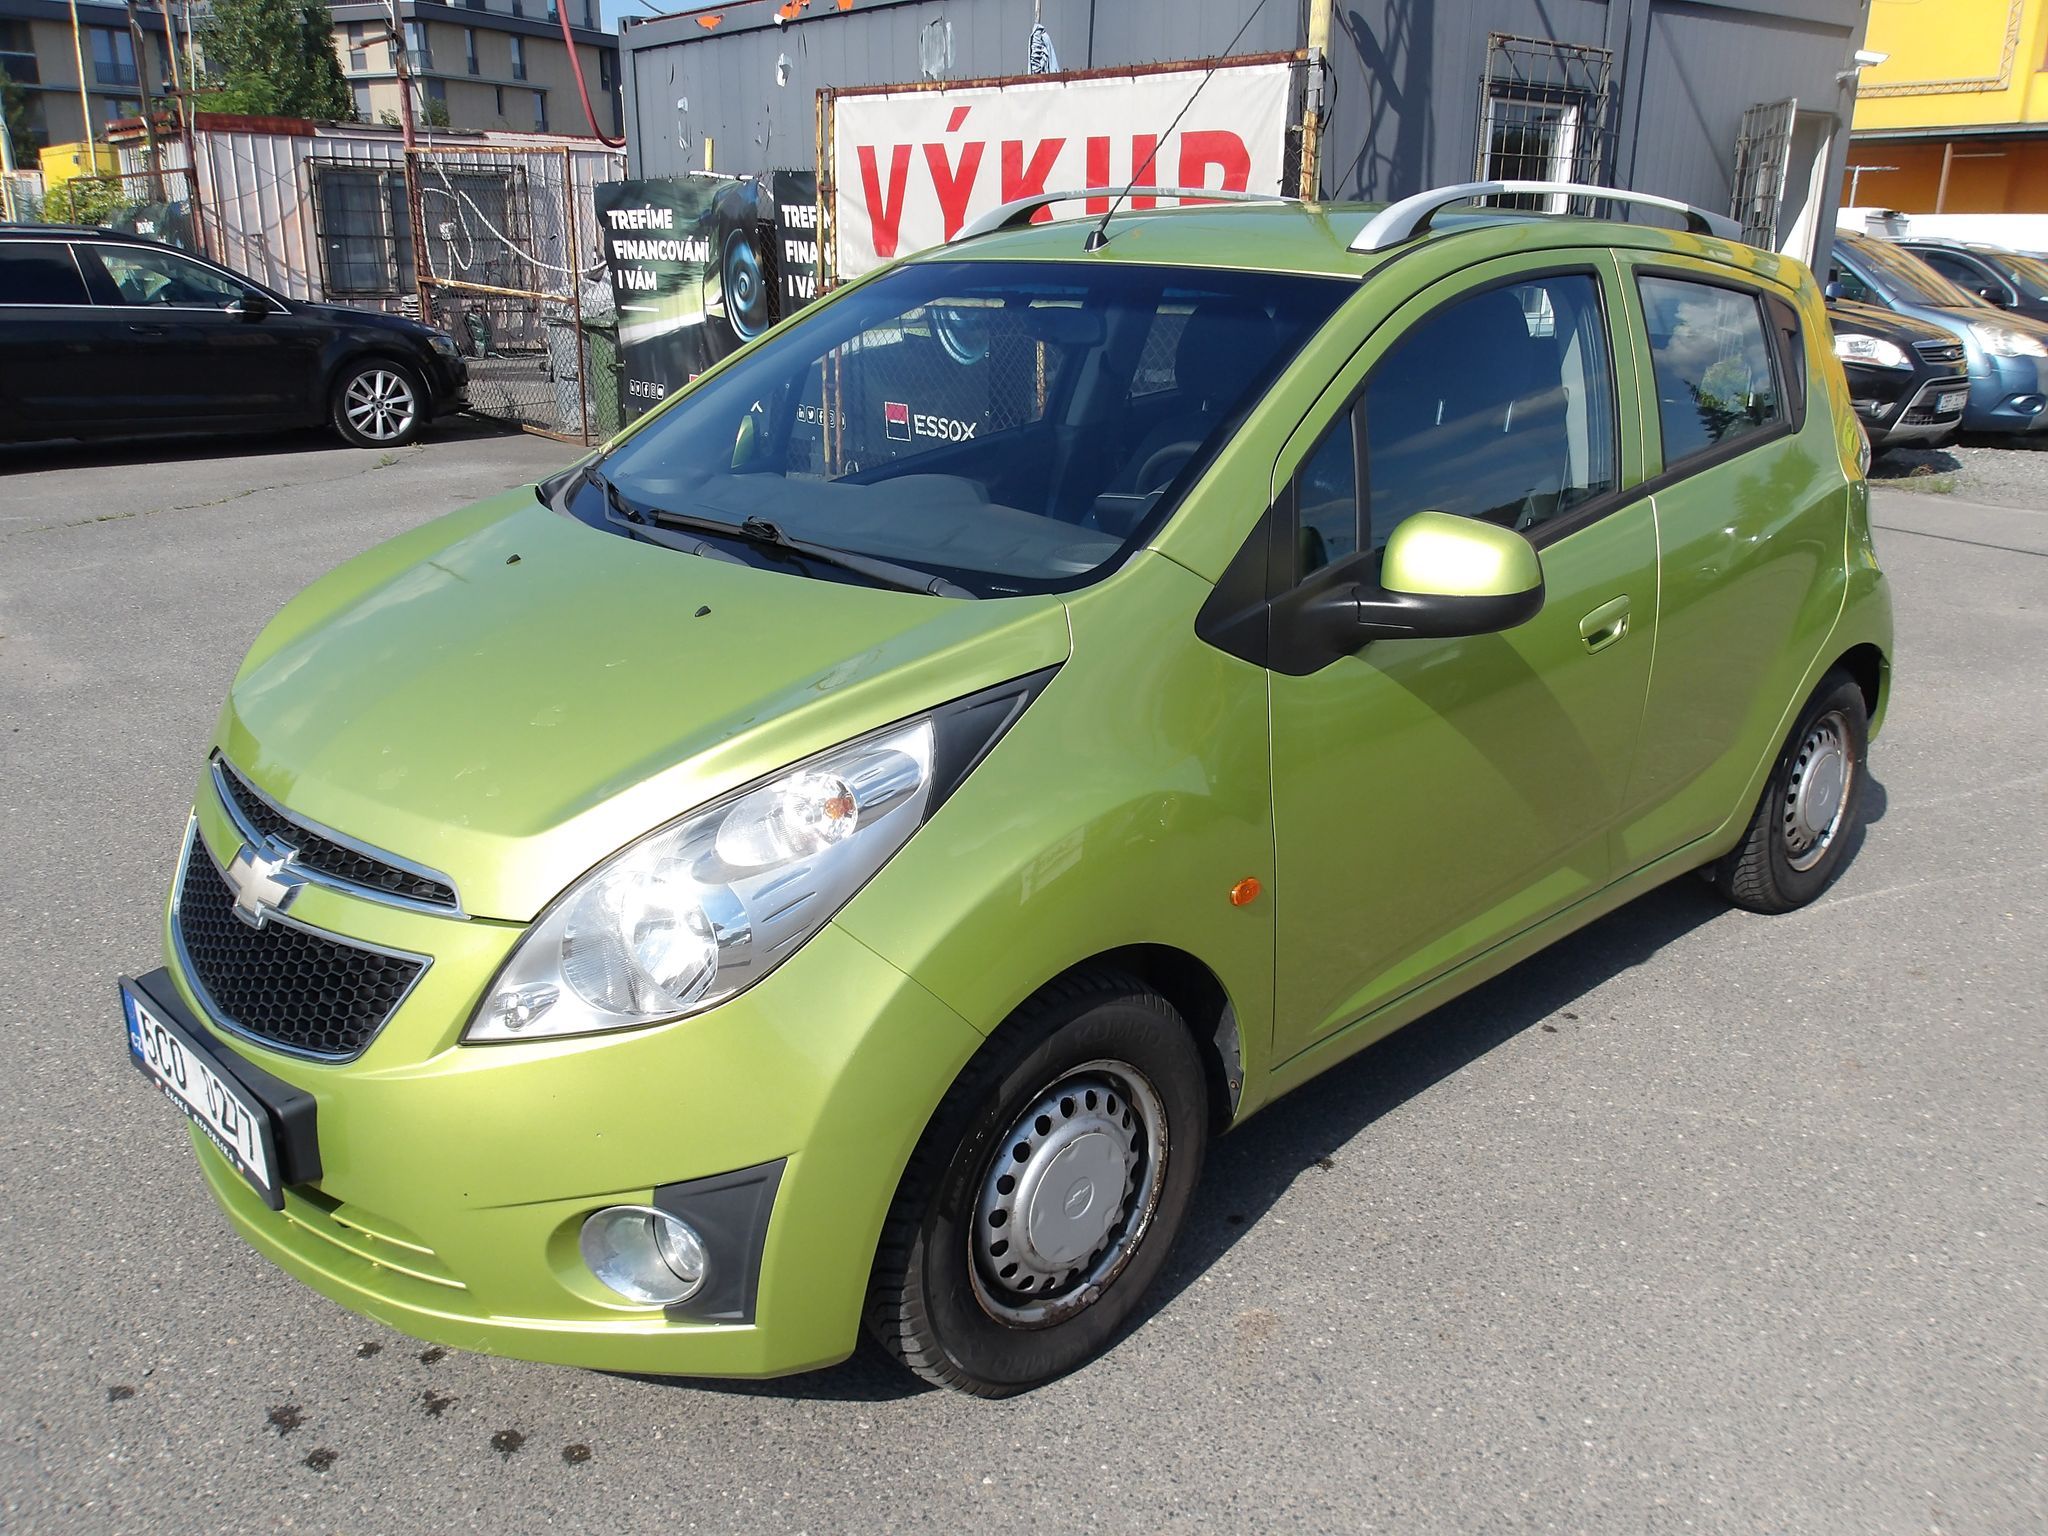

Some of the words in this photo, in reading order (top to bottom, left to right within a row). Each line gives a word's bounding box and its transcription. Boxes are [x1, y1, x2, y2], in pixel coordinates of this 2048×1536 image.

[856, 105, 1251, 258] VÝKUP
[606, 203, 673, 230] TREFÍME
[612, 235, 710, 263] FINANCOVÁNÍ
[617, 269, 623, 289] I
[625, 266, 657, 291] VÁM
[913, 413, 977, 442] ESSOX
[193, 1113, 234, 1163] REPUBLIKA
